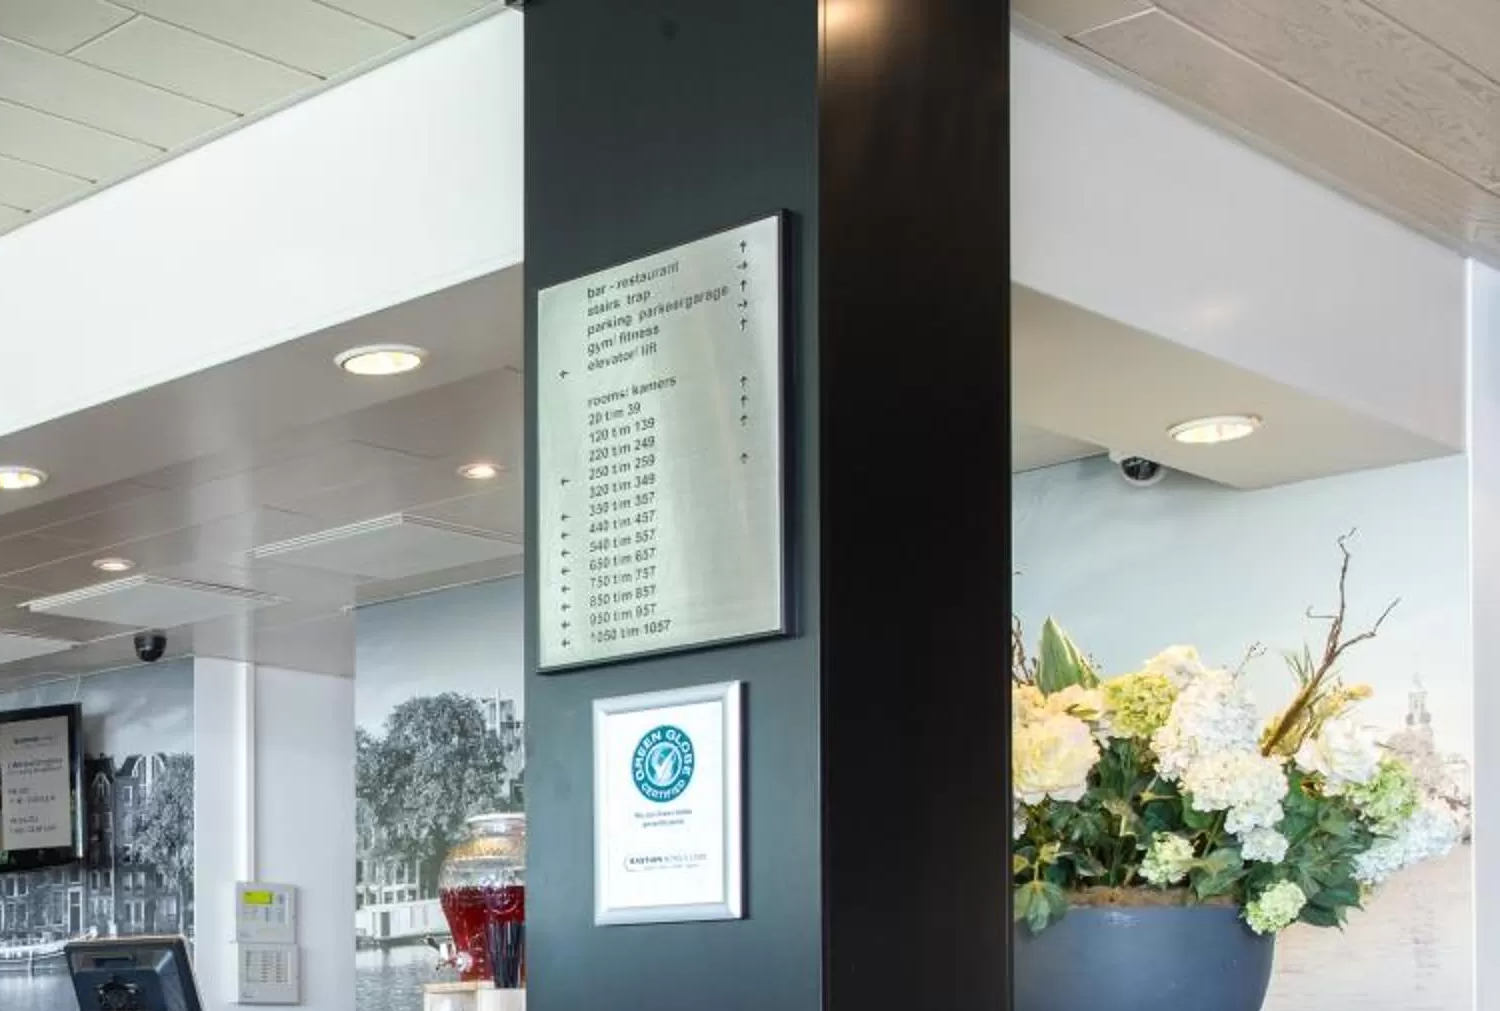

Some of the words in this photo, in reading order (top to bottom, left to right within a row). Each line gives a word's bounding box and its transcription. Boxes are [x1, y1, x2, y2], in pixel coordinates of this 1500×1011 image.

[587, 285, 606, 299] bar
[617, 261, 678, 289] restaurant
[628, 401, 641, 416] 39
[589, 428, 609, 444] 120
[635, 417, 655, 432] 139
[634, 435, 655, 451] 249
[643, 619, 671, 634] 1057
[635, 730, 662, 781] GREEN
[665, 729, 693, 776] GLOBE
